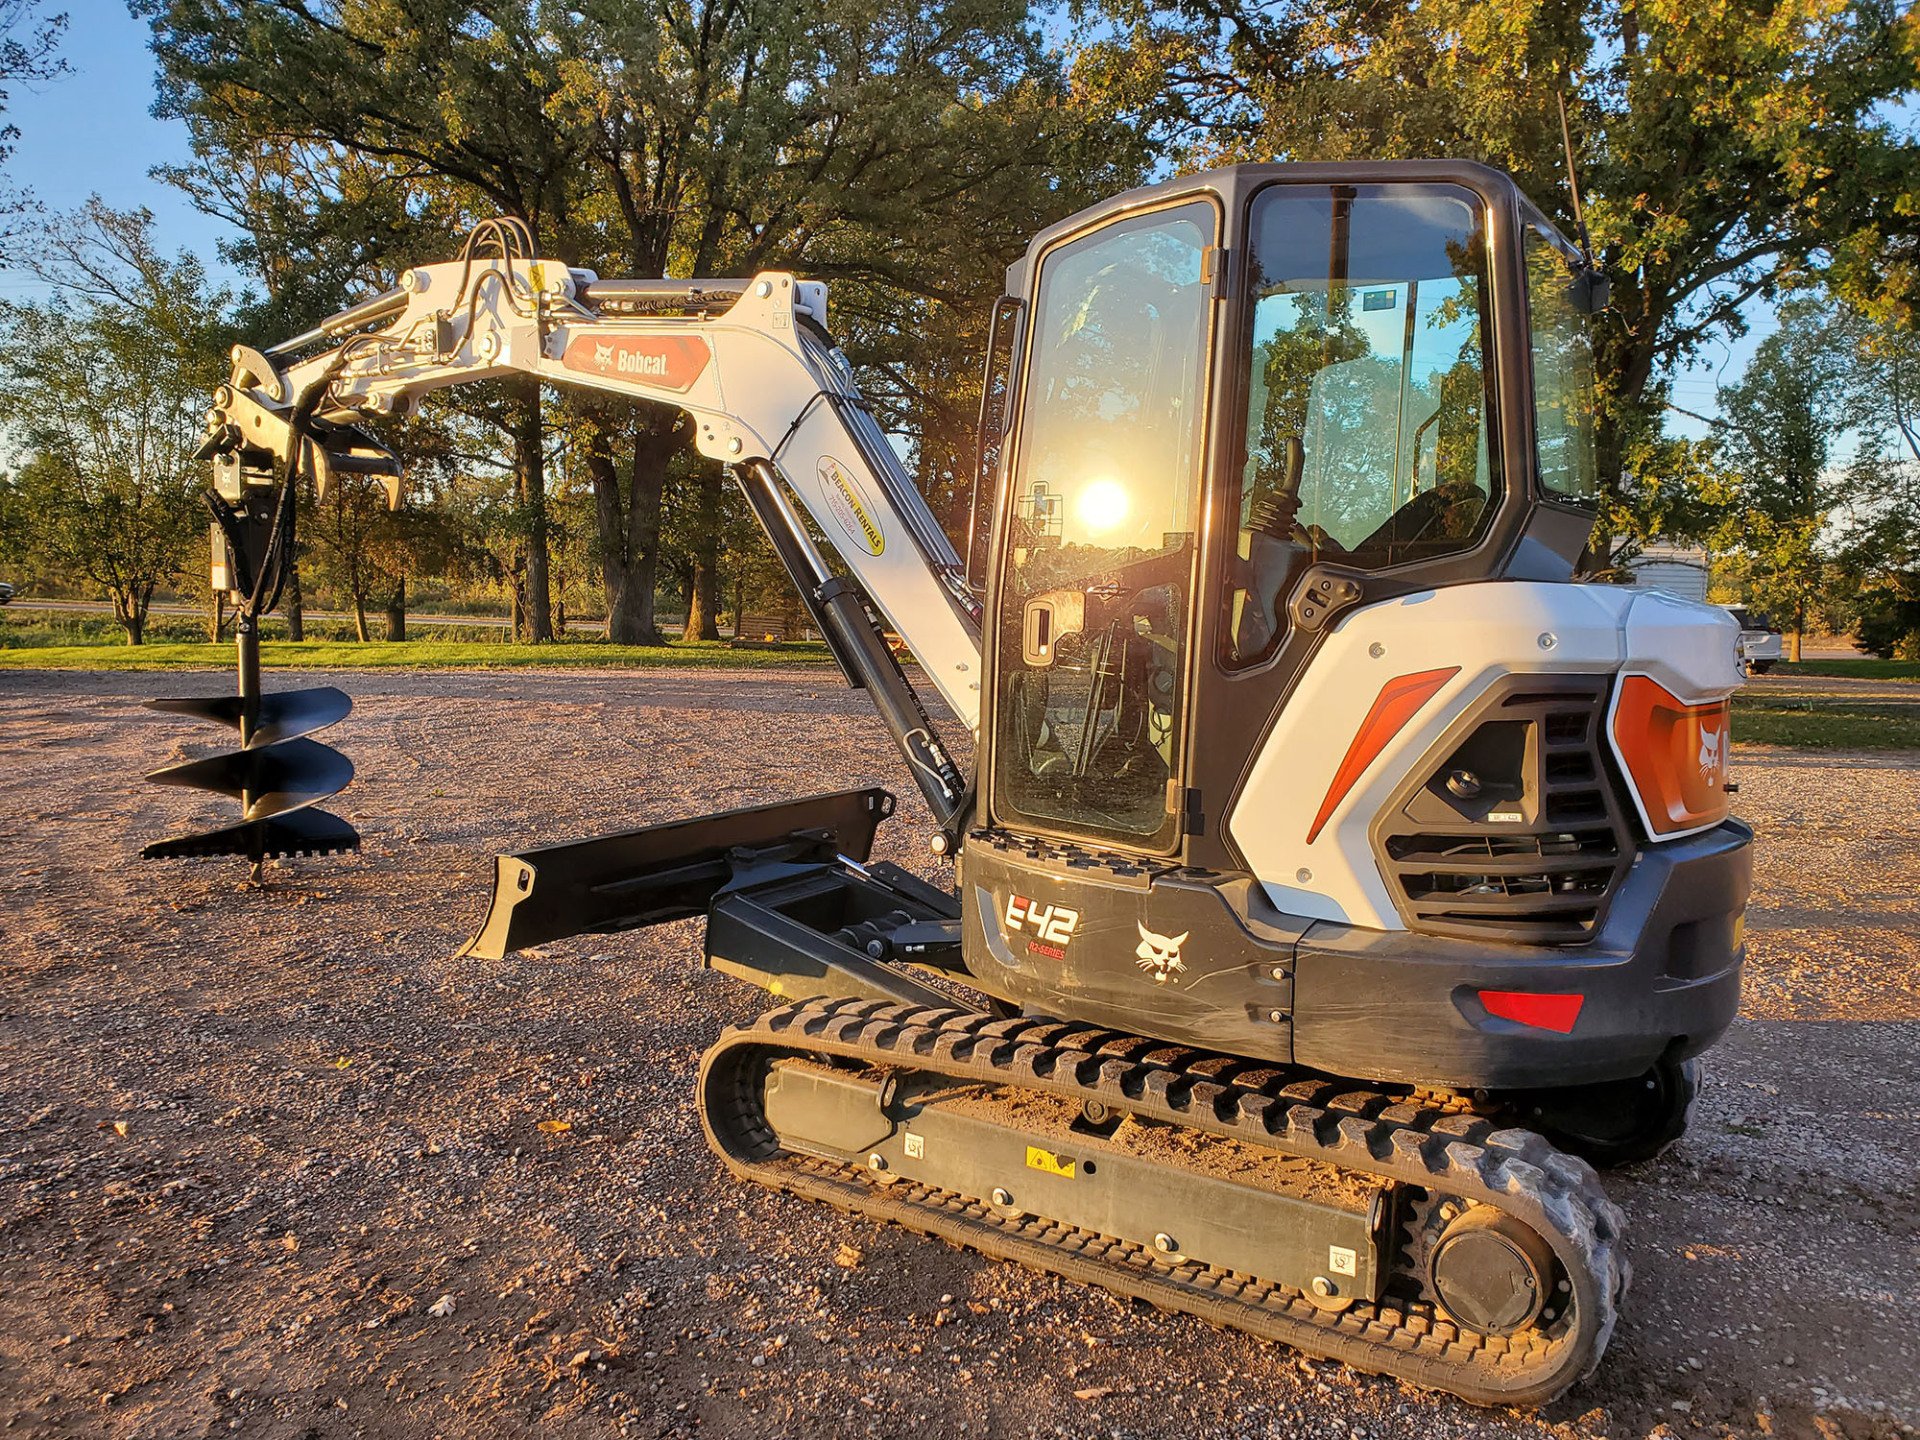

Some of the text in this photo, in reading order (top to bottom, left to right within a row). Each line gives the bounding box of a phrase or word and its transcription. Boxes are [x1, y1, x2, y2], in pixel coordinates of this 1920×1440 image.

[617, 349, 667, 375] Bobcat
[831, 471, 856, 509] BEACON
[854, 507, 881, 548] RENTALS
[1004, 894, 1080, 945] E42
[1029, 941, 1066, 960] R2-SERIES
